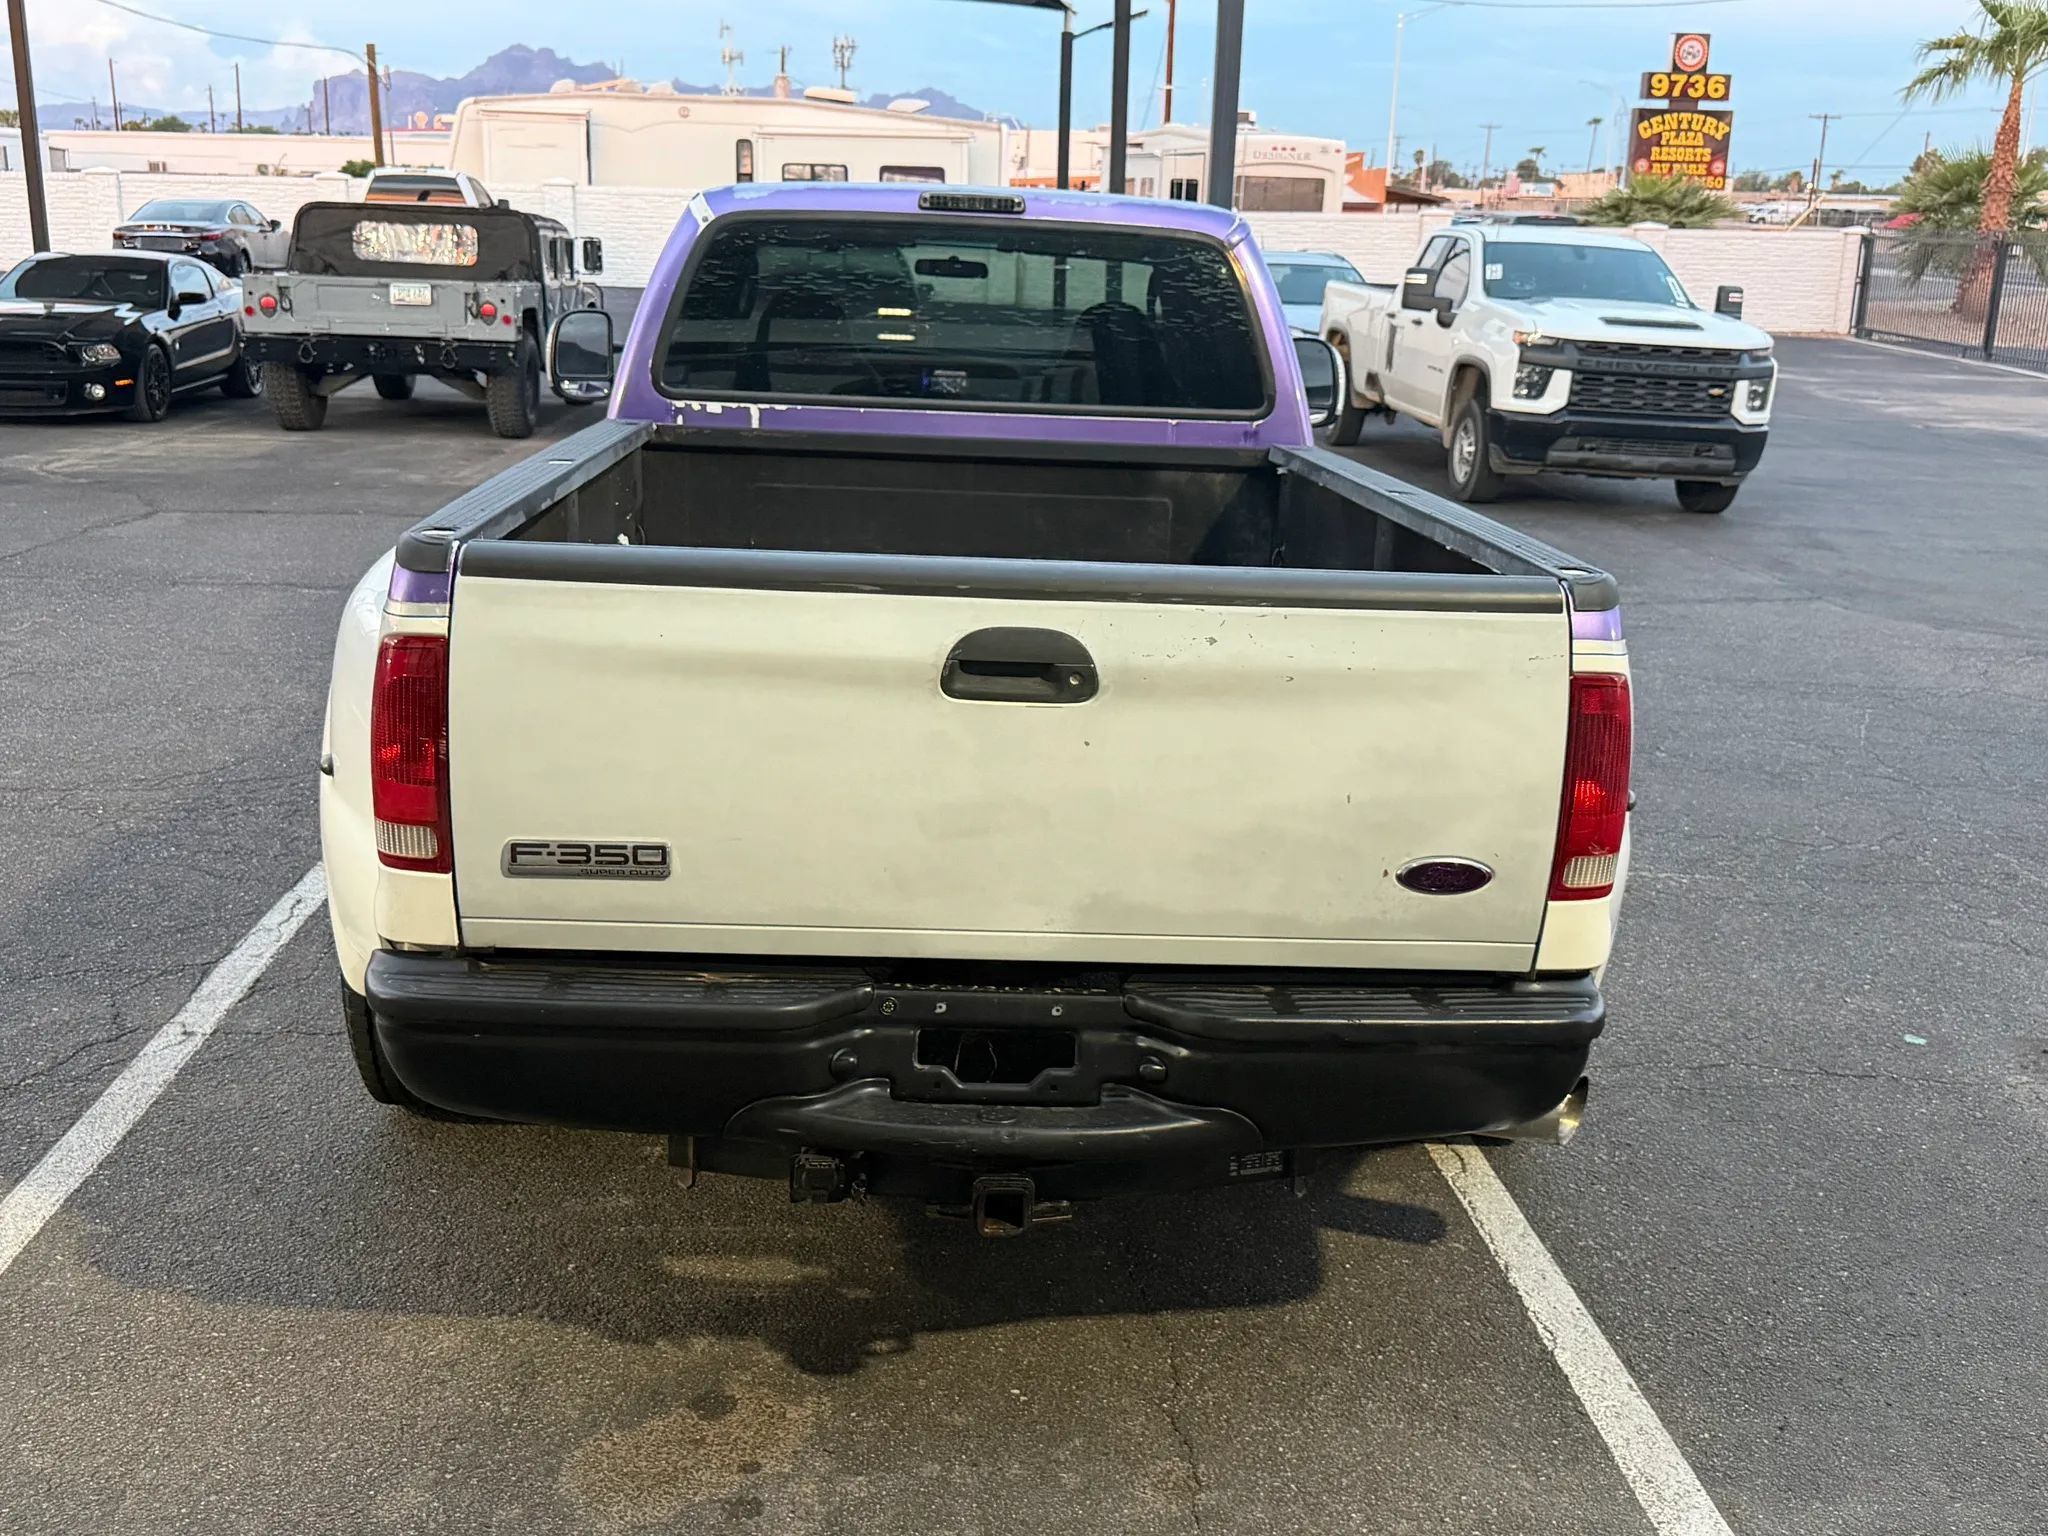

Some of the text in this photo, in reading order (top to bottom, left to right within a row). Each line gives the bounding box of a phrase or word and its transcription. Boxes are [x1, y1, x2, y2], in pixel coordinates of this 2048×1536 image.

[1651, 74, 1726, 98] 9736
[1638, 112, 1729, 141] CENTURY
[1661, 131, 1704, 146] PLAZA
[1650, 146, 1712, 162] RESORTS
[1652, 162, 1671, 174] RV
[1577, 357, 1740, 377] CHEVROLET
[510, 842, 667, 866] F-350
[580, 868, 666, 877] SUPER DUTY
